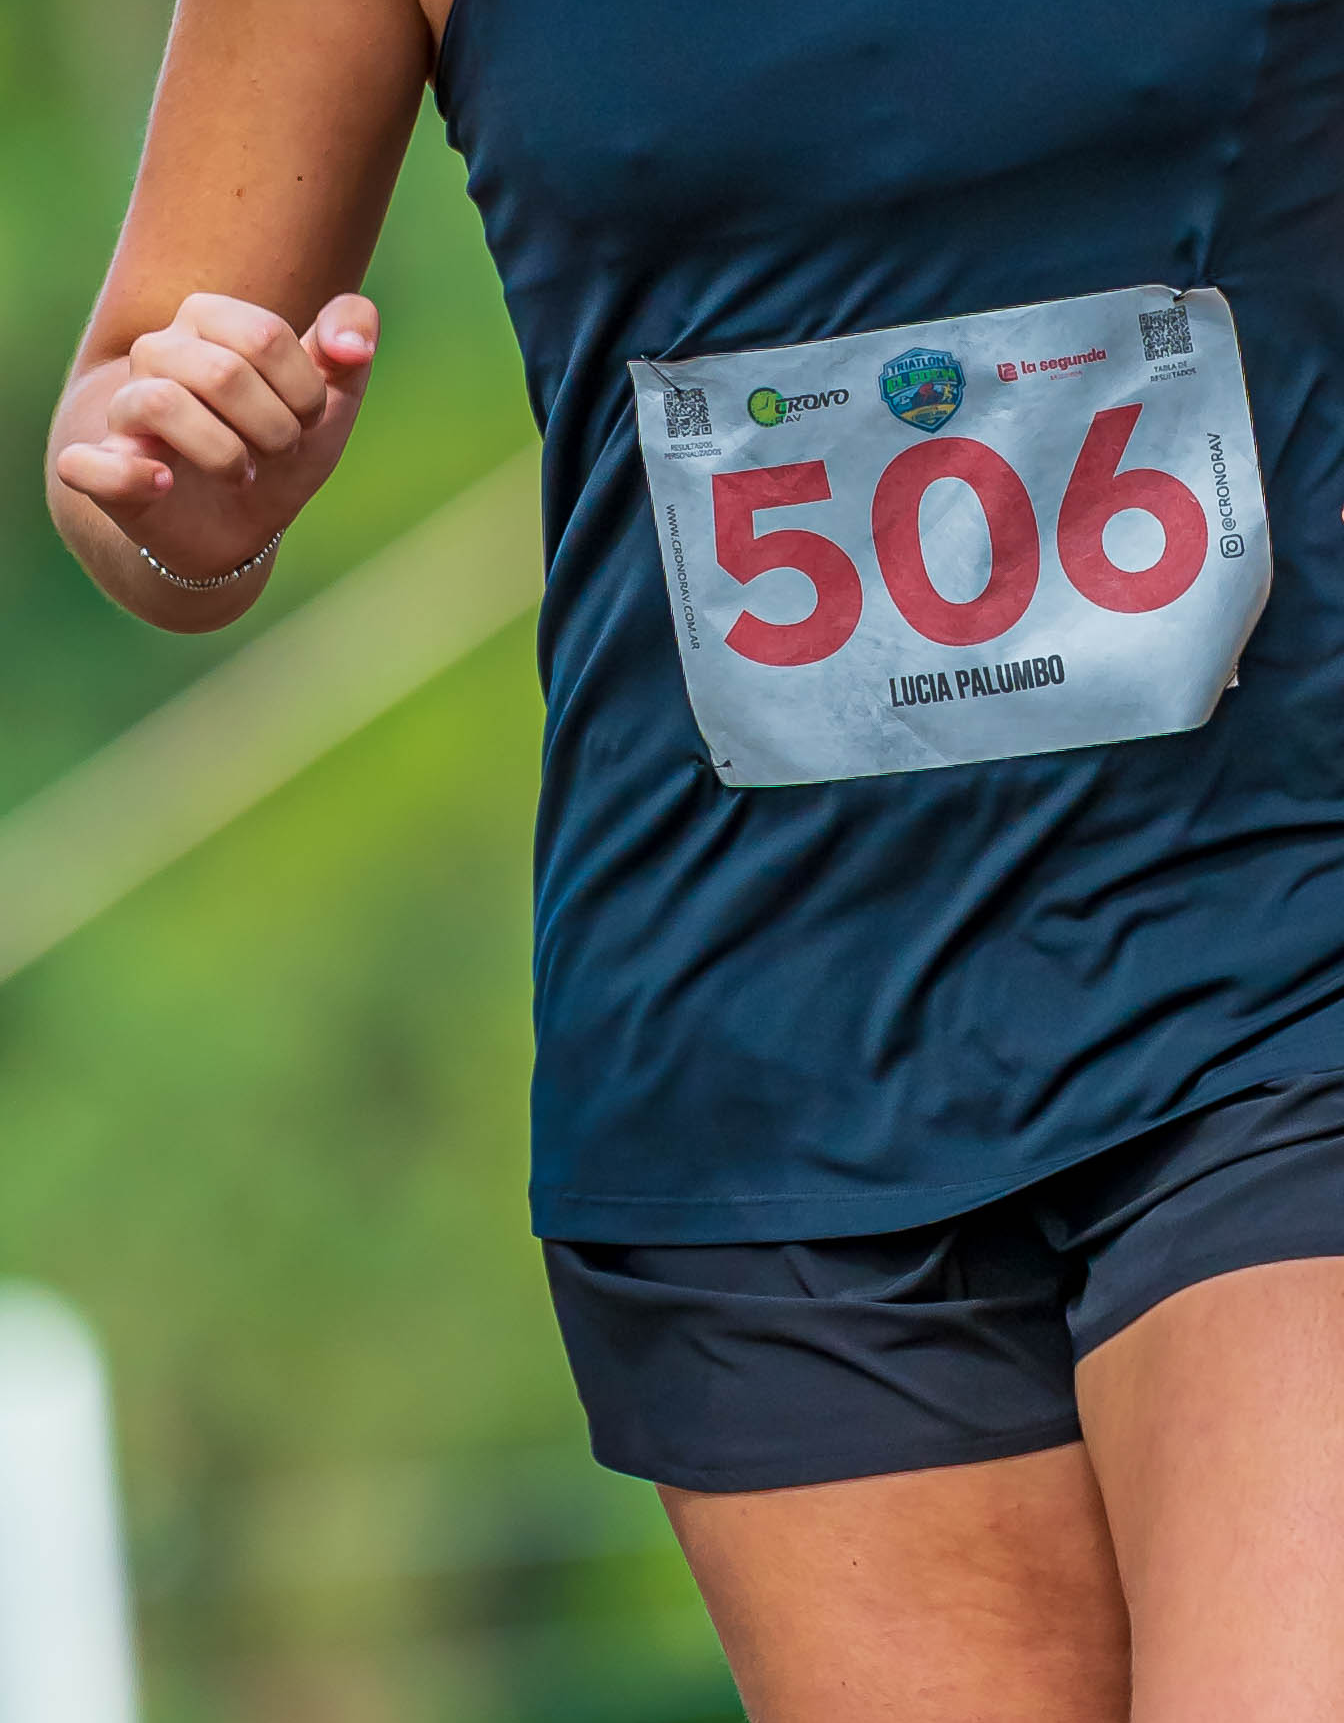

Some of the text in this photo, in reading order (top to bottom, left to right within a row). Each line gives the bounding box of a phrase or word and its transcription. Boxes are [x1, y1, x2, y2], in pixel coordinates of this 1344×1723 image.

[889, 356, 945, 376] TRIATLON
[1020, 360, 1037, 375] la
[1039, 348, 1107, 371] segunda
[1154, 363, 1177, 373] TABLA
[1150, 367, 1197, 382] RESULTADOS
[774, 388, 850, 415] CRONO
[775, 412, 803, 426] RAV
[663, 448, 723, 460] PERSONALIZADOS
[670, 440, 714, 452] RESULTADOS
[1206, 432, 1237, 532] @CRONORAV
[712, 403, 1209, 667] 506
[666, 503, 701, 651] WWW.CRONORAV.COM.AR
[889, 654, 1066, 708] LUCIA PALUMBO
